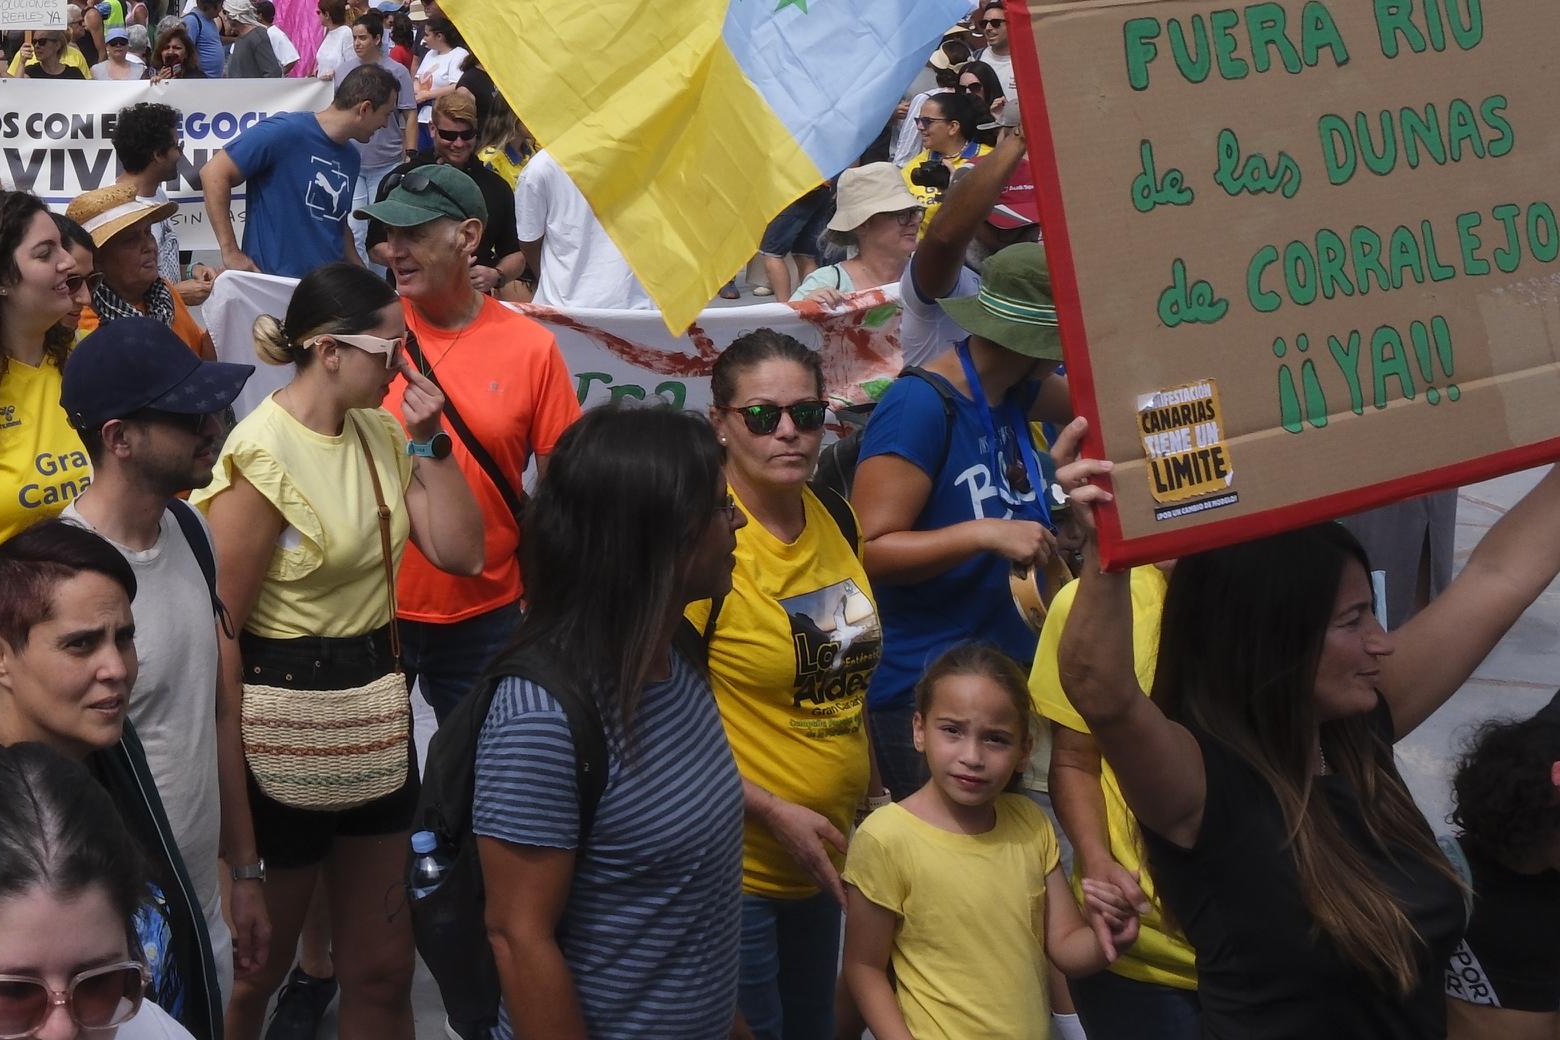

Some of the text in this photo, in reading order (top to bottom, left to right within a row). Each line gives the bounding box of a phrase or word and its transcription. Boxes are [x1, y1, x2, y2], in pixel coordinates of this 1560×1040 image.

[2, 11, 61, 24] REALES YA
[1123, 1, 1349, 91] FUERA
[25, 112, 94, 140] CON
[1131, 94, 1514, 212] de las DUNAS
[170, 212, 202, 225] SIN
[1157, 201, 1560, 328] de CORRALEJO
[0, 419, 23, 430] hummel
[1142, 398, 1216, 434] CANARIAS
[1144, 421, 1220, 459] TIENE UN
[35, 450, 88, 476] Gra
[18, 476, 91, 508] Cana
[795, 633, 840, 676] La
